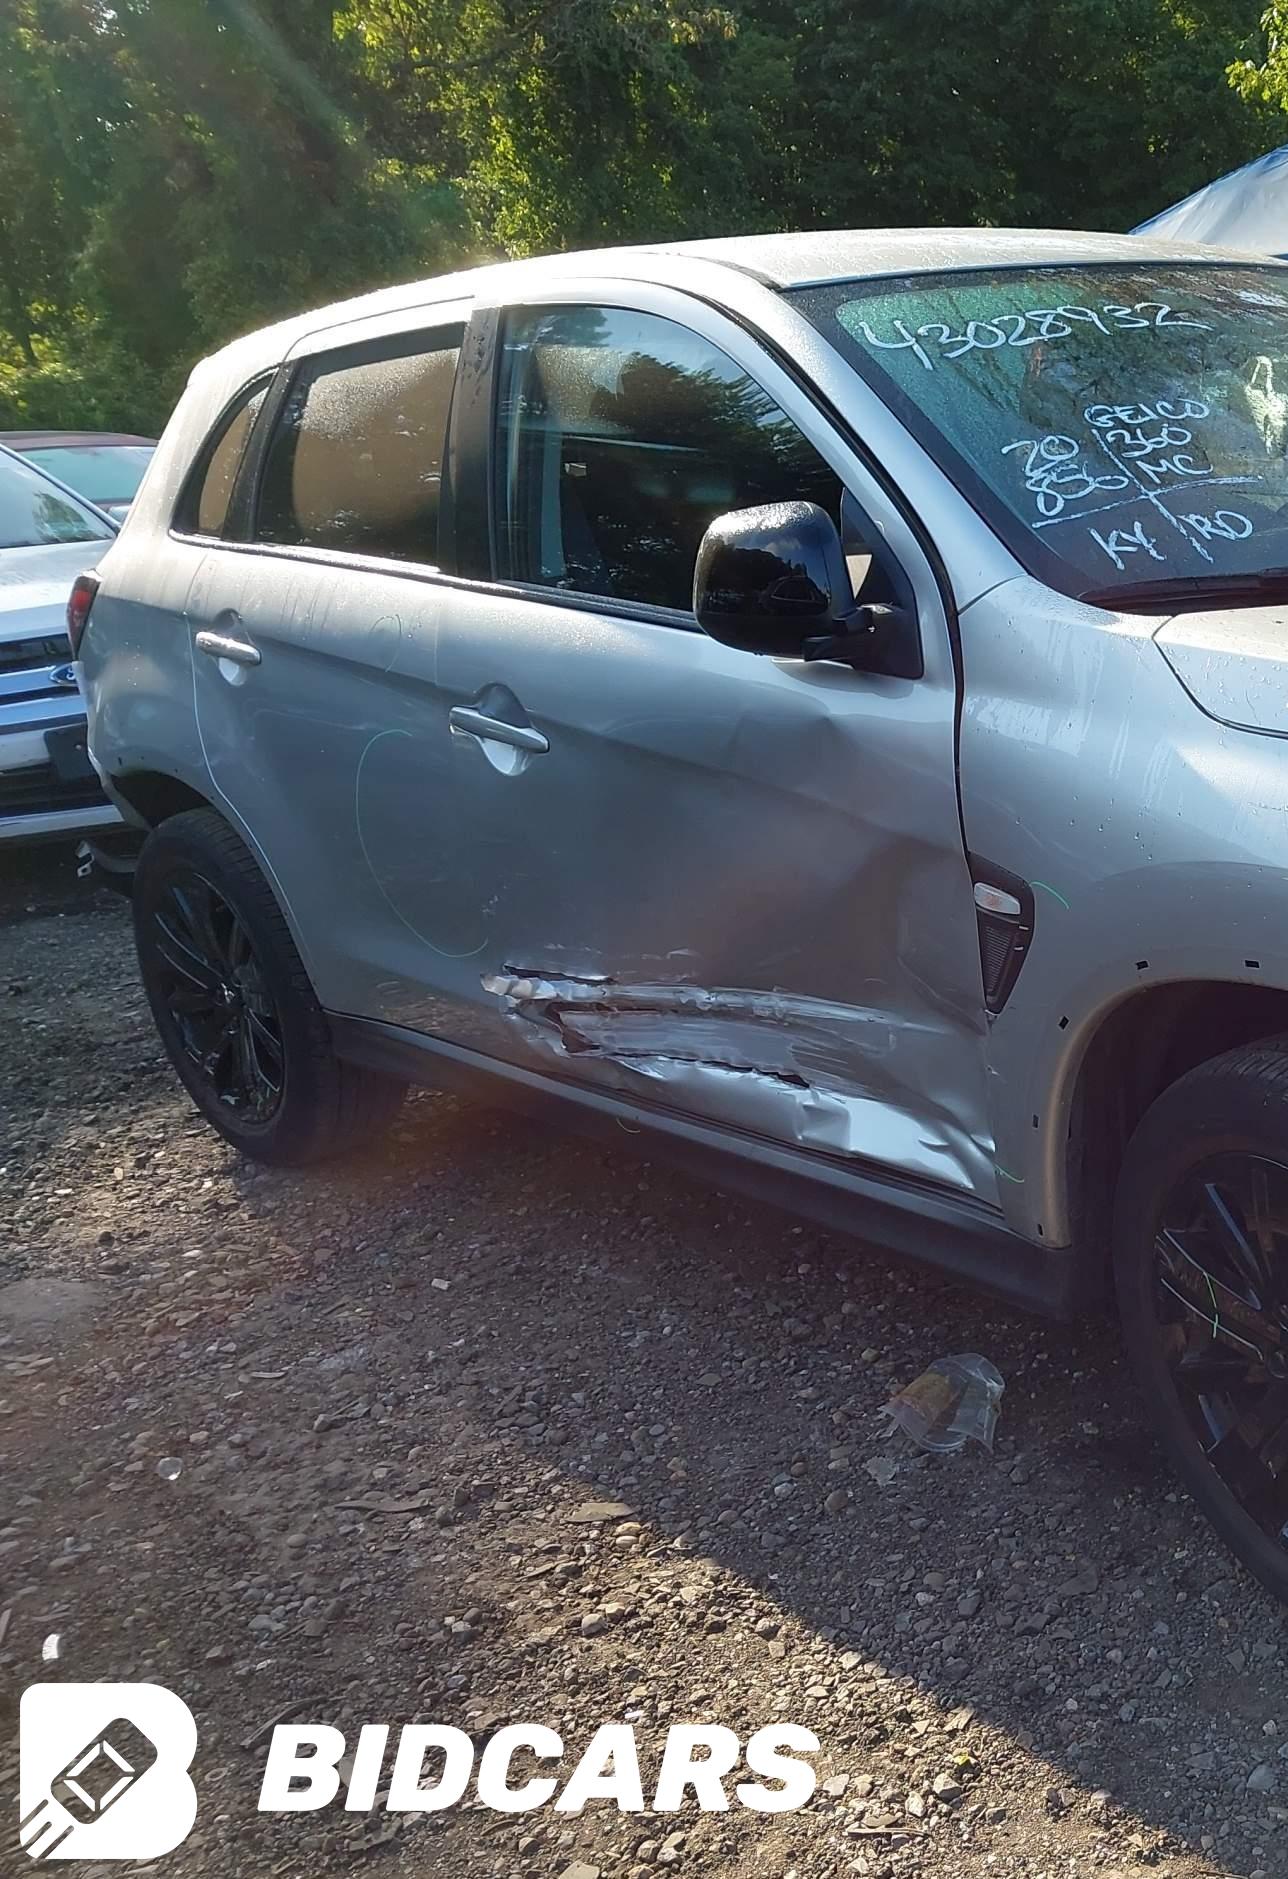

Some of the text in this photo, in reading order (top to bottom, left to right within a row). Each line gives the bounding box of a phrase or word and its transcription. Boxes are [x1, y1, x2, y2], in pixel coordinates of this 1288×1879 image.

[857, 302, 1214, 371] 43028932
[1106, 424, 1192, 458] 360
[1136, 454, 1214, 484] MC
[1087, 521, 1167, 570] KY
